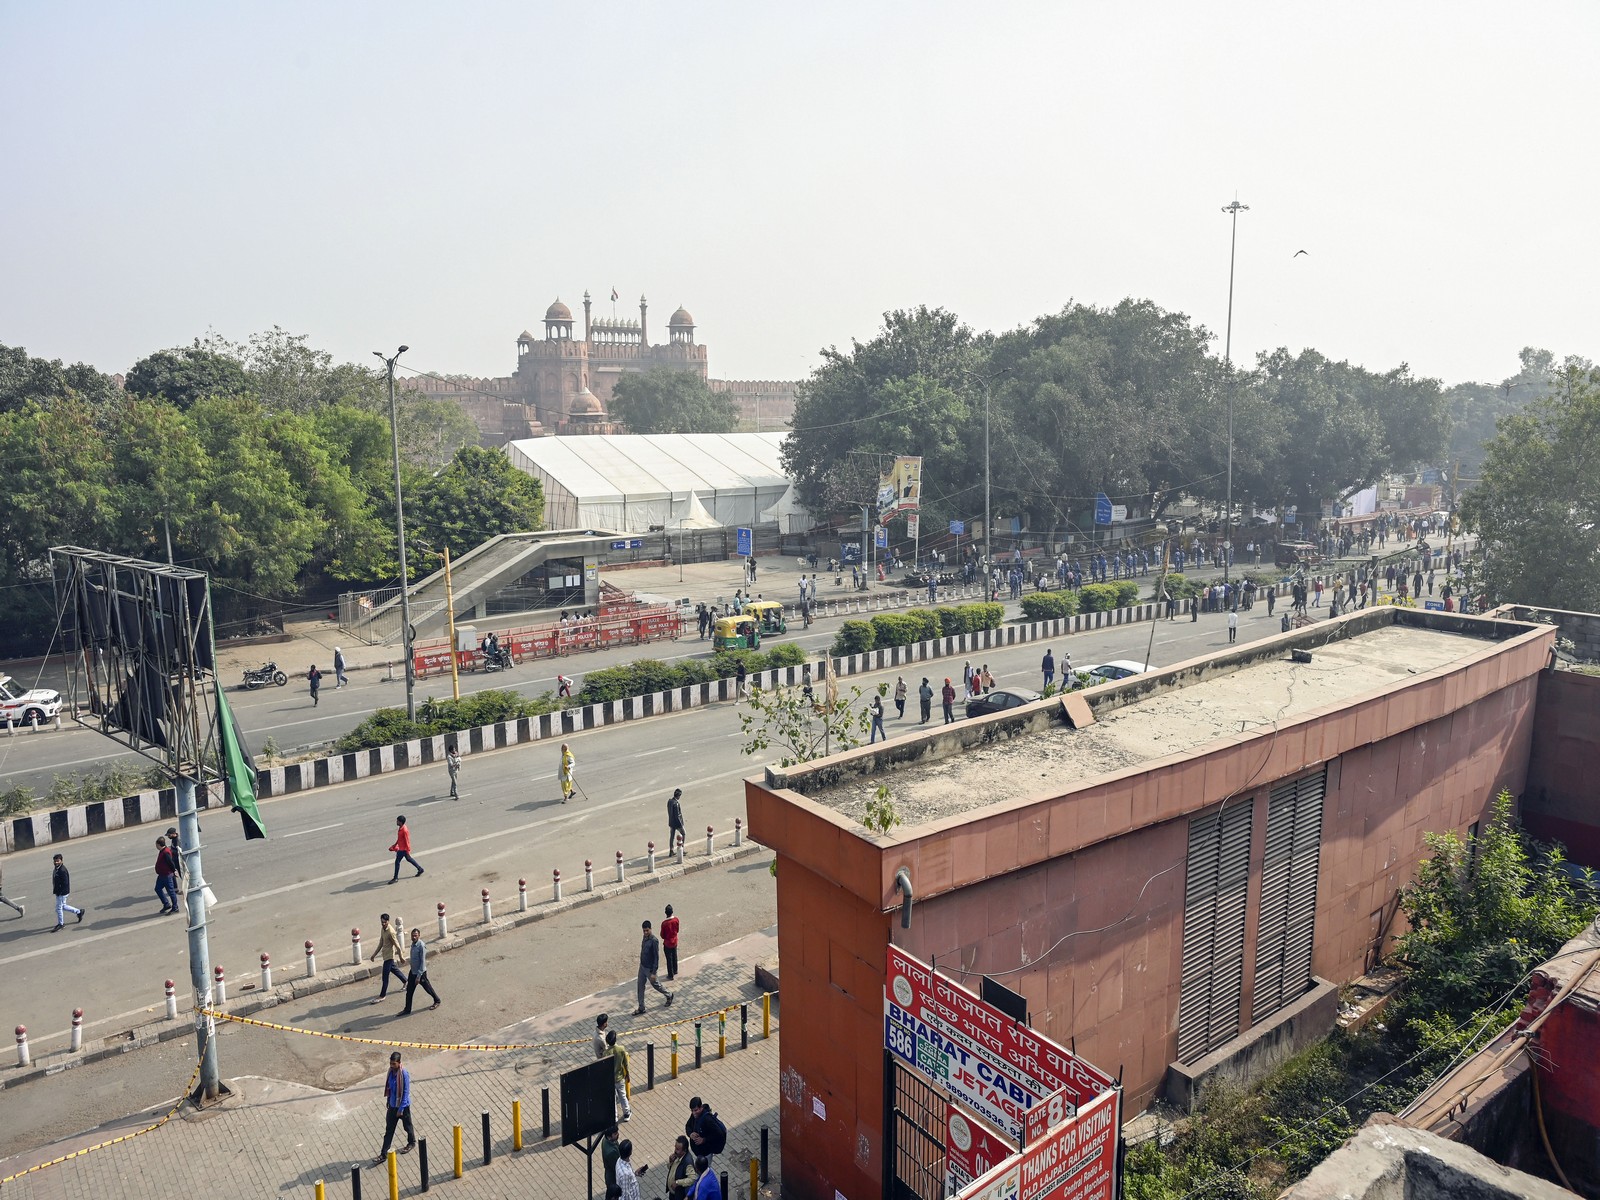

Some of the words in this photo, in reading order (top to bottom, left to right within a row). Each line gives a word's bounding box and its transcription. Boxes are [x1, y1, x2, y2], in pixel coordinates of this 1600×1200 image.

[889, 1024, 912, 1059] 586
[890, 1002, 971, 1066] BHARAT
[893, 954, 932, 989] लाला
[936, 981, 1003, 1033] लाजपत
[1007, 1024, 1041, 1057] राय
[1046, 1049, 1109, 1096] वाटिक
[919, 990, 959, 1022] स्वच्छ
[962, 1018, 1004, 1054] भारत
[945, 1025, 974, 1048] कदम
[1025, 1076, 1042, 1094] की
[1028, 1105, 1047, 1127] GATE
[1047, 1094, 1064, 1128] 8
[1031, 1123, 1044, 1139] NO.
[1022, 1141, 1058, 1186] THANKS
[1059, 1129, 1077, 1160] FOR
[1078, 1103, 1112, 1146] VISITING
[1022, 1182, 1038, 1200] OLD
[1040, 1160, 1067, 1187] LAJPAT
[1068, 1149, 1080, 1167] RAI
[1082, 1128, 1110, 1157] MARKET
[950, 1162, 970, 1183] ASIA'S
[1063, 1174, 1083, 1198] Central
[1083, 1165, 1098, 1183] Radio
[1084, 1169, 1110, 1196] Merchants
